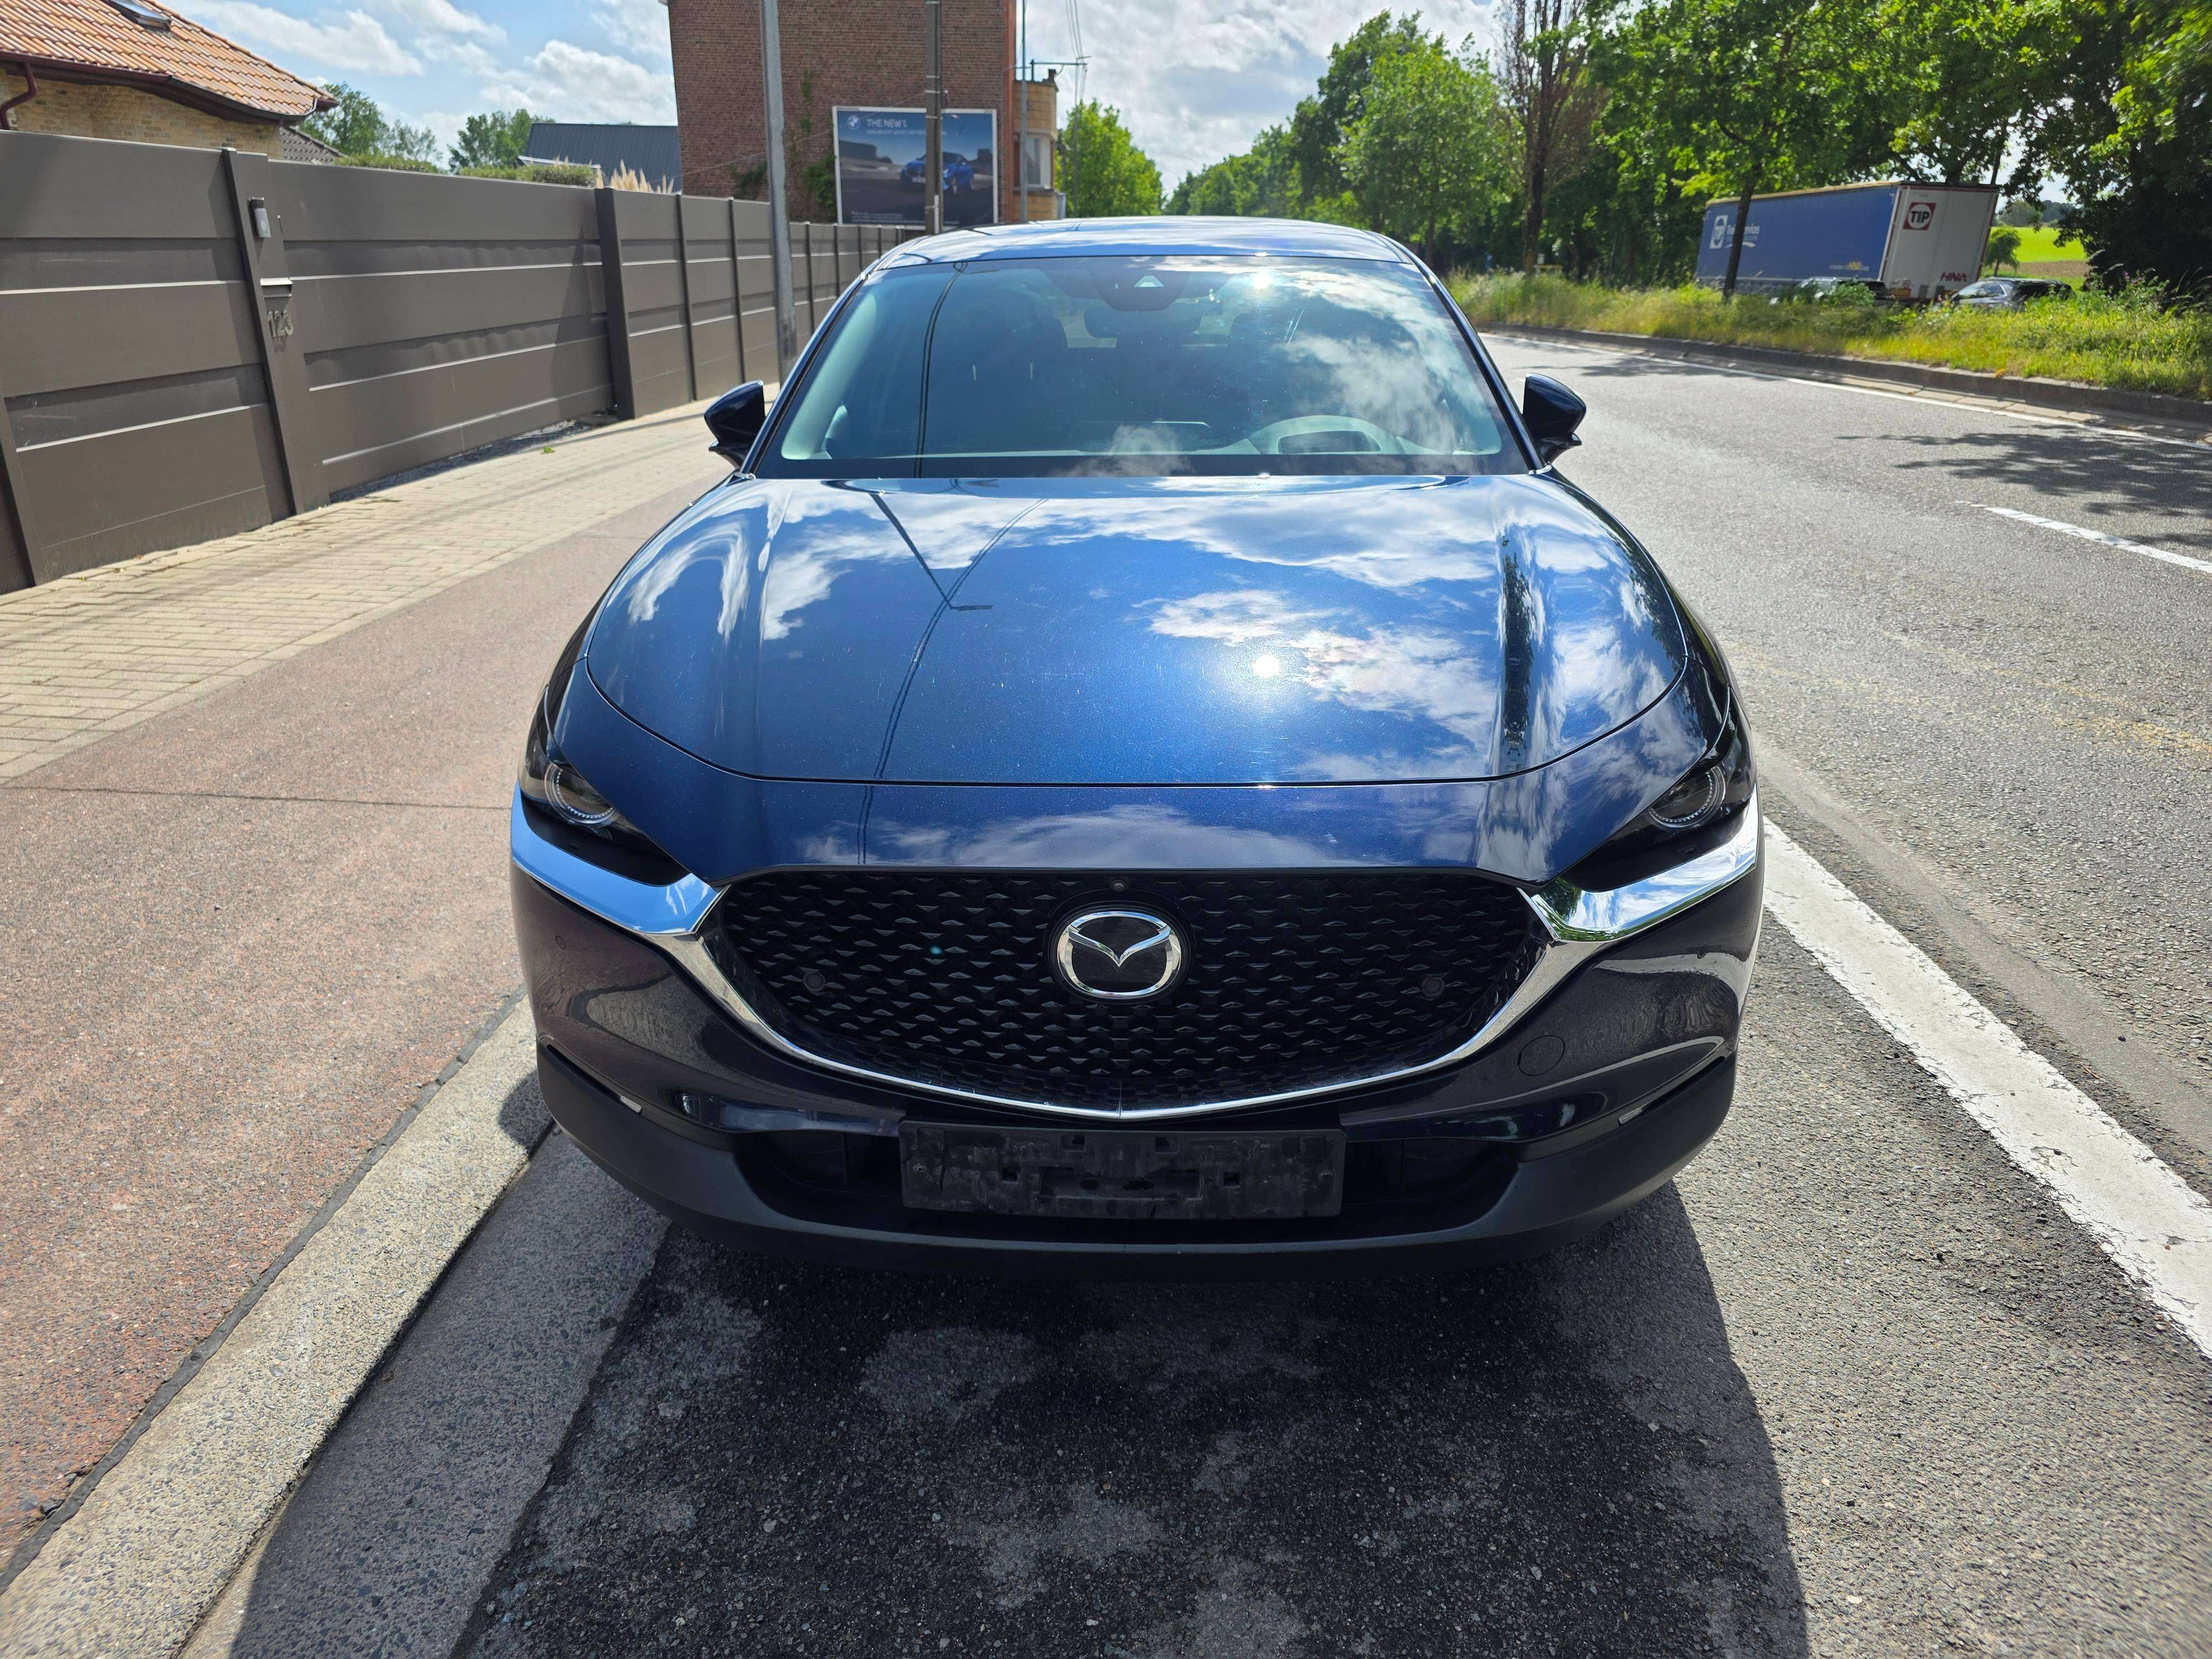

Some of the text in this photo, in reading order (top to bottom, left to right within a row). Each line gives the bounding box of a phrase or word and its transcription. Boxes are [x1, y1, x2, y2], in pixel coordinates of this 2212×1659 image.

[866, 118, 883, 127] THE
[884, 119, 902, 128] NEW
[1911, 211, 1930, 223] TIP
[265, 310, 294, 337] 123
